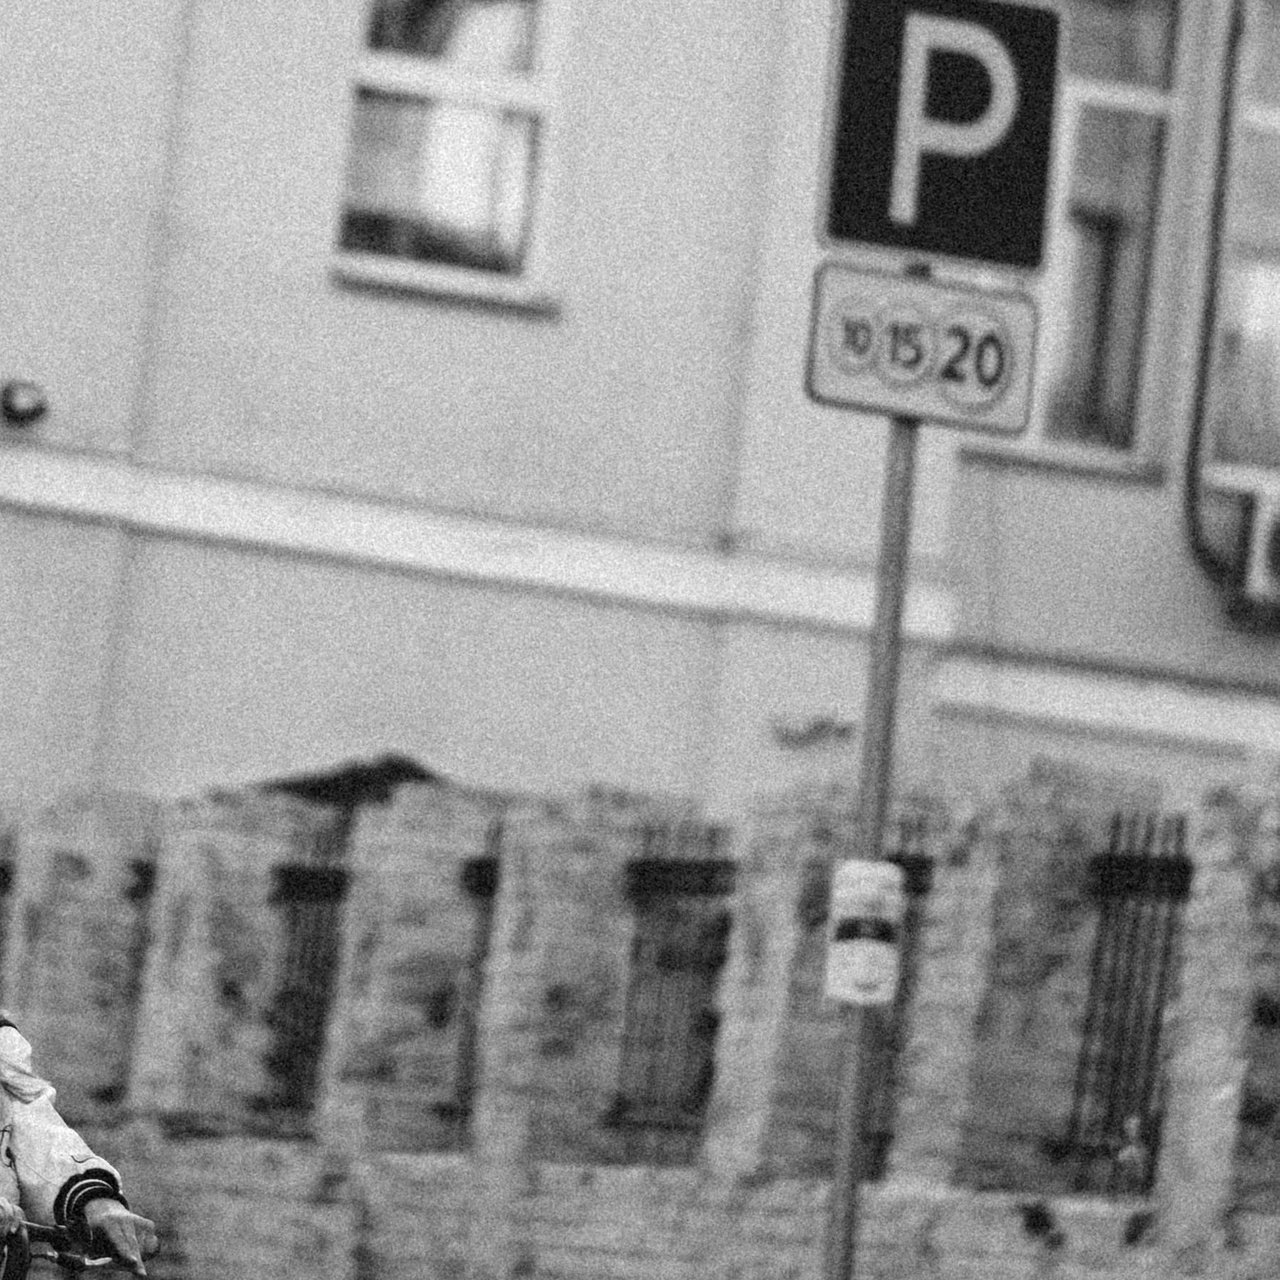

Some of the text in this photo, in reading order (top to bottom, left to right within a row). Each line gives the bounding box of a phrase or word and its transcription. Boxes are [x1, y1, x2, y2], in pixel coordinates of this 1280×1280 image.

[888, 13, 1017, 223] P
[842, 318, 1005, 389] 10 15 20
